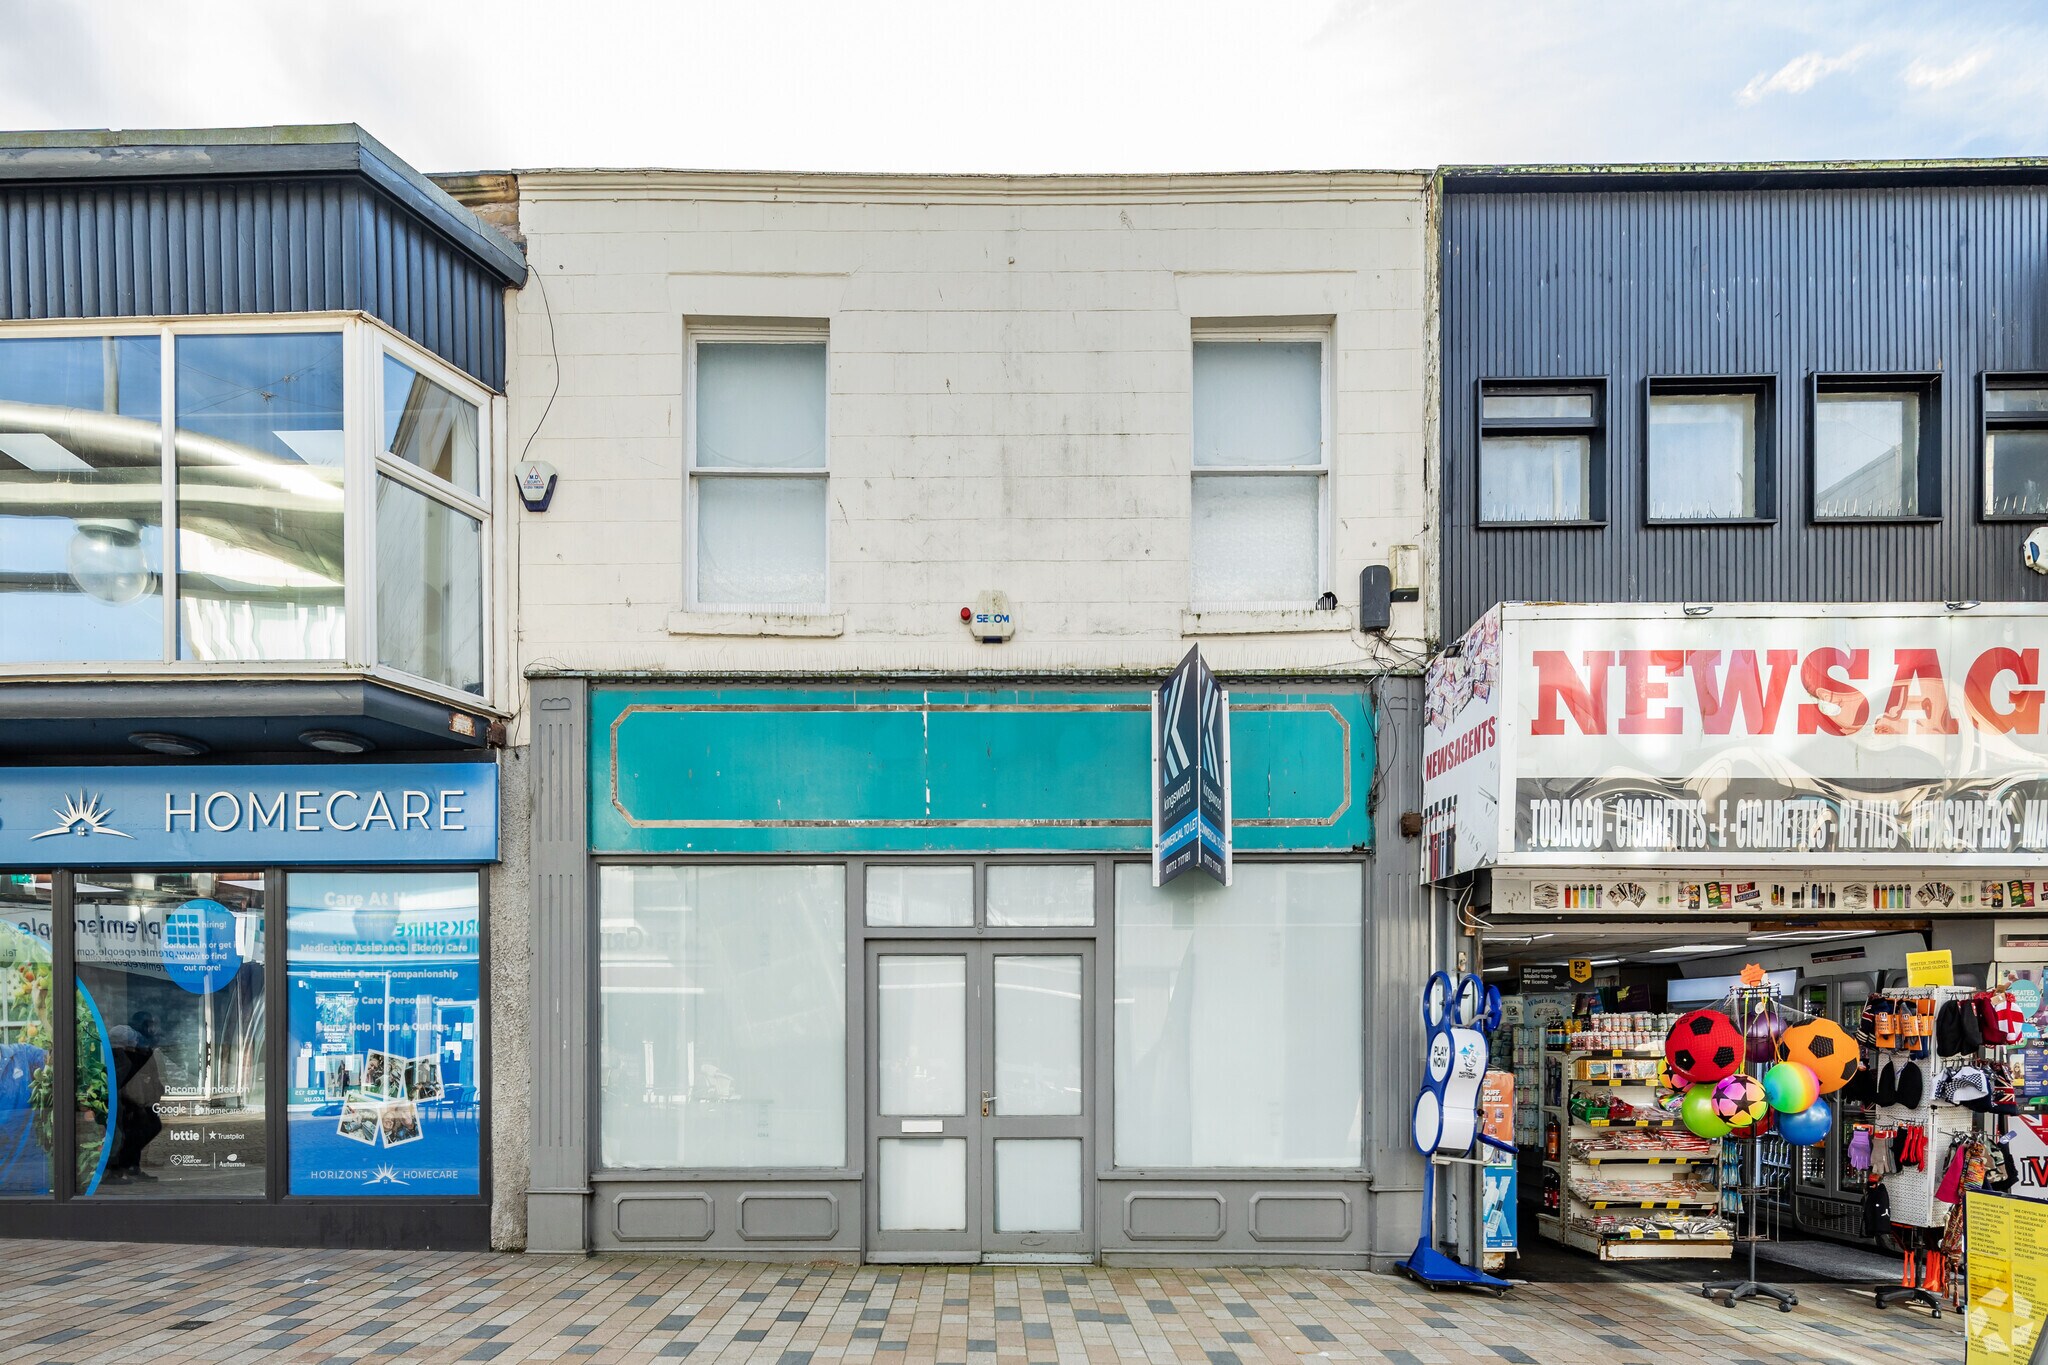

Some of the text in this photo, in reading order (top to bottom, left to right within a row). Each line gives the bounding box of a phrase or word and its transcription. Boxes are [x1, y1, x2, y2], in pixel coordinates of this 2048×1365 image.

[976, 614, 1010, 623] SECOM
[1531, 647, 2047, 736] NEWSAG
[1426, 715, 1496, 782] NEWSAGENTS
[1164, 776, 1191, 811] kingswood
[1203, 779, 1222, 811] kingswood
[164, 789, 466, 833] HOMECARE
[1530, 799, 1604, 848] TOBACCO
[1615, 799, 1707, 848] CIGARETTES
[1910, 799, 2012, 849] NEWSPAPERS
[1160, 827, 1183, 853] COMMERCIAL
[324, 891, 364, 907] Care
[368, 892, 388, 907] At
[201, 920, 227, 930] hiring!
[219, 942, 232, 951] get
[300, 943, 468, 954] Medication Assistance Elderly Care
[210, 953, 228, 961] find
[184, 964, 196, 972] out
[198, 964, 222, 972] more!
[386, 969, 459, 980] Companionship
[362, 996, 383, 1005] Care
[349, 1022, 371, 1033] Help
[1434, 1046, 1448, 1056] PLAY
[1433, 1058, 1448, 1068] NOW
[164, 1085, 235, 1094] Recommended
[152, 1102, 187, 1116] Google
[170, 1130, 200, 1141] lottie
[218, 1133, 245, 1141] Trustpilot
[310, 1170, 368, 1180] HORIZONS
[403, 1170, 459, 1180] HOMECARE
